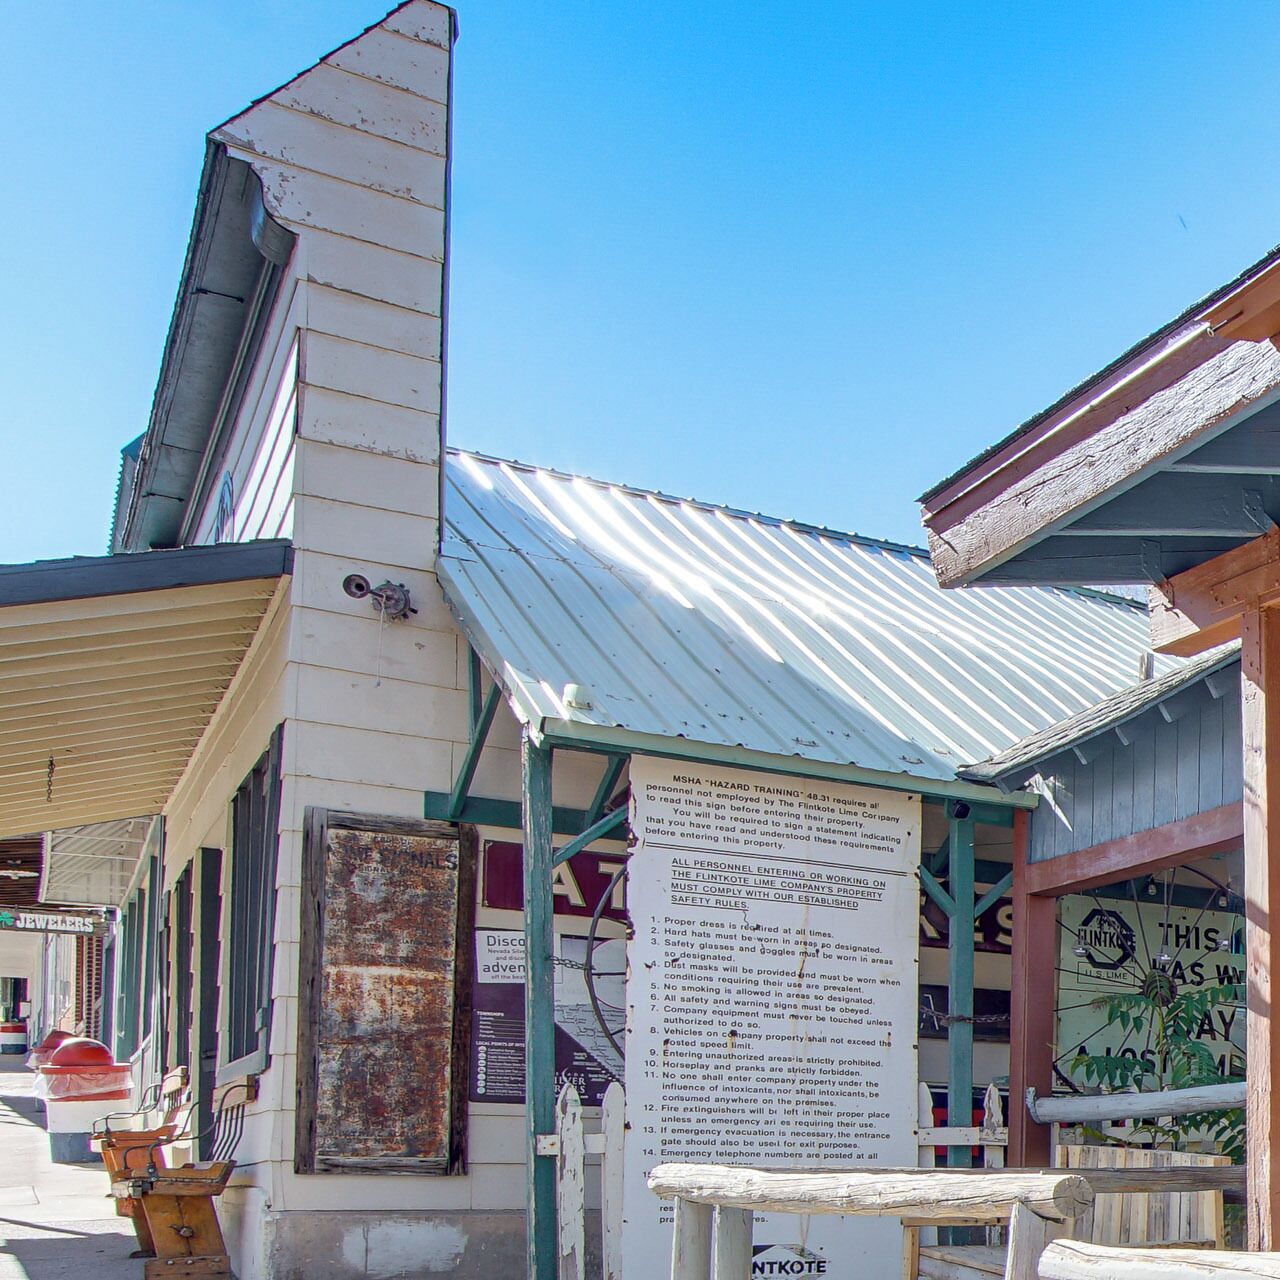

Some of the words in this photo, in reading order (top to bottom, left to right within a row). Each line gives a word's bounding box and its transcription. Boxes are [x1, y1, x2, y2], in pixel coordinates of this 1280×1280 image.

[646, 784, 693, 796] personnel
[696, 790, 713, 798] not
[716, 792, 760, 804] employed
[763, 796, 775, 807] by
[778, 798, 794, 808] The
[798, 801, 836, 814] Flintkote
[838, 807, 858, 817] Lime
[672, 775, 702, 785] MSHA
[705, 779, 750, 792] "HAZARD
[753, 785, 804, 798] TRAINING"
[806, 792, 830, 802] 48.31
[832, 797, 867, 808] requires
[646, 794, 656, 802] to
[659, 796, 682, 805] read
[684, 798, 702, 808] this
[706, 801, 726, 811] sign
[730, 803, 761, 814] before
[763, 809, 801, 820] entering
[804, 813, 824, 822] their
[826, 817, 865, 829] property.
[646, 815, 665, 825] that
[668, 819, 686, 827] you
[689, 820, 712, 830] have
[715, 825, 736, 833] read
[739, 828, 757, 836] and
[759, 830, 811, 842] understood
[813, 835, 837, 845] these
[840, 840, 894, 853] requirements
[672, 807, 691, 817] You
[694, 811, 711, 819] will
[714, 812, 726, 821] be
[729, 816, 769, 826] required
[771, 820, 781, 828] to
[784, 821, 803, 831] sign
[815, 826, 858, 838] statement
[860, 831, 901, 845] indicating
[645, 826, 676, 837] before
[680, 832, 719, 843] entering
[722, 835, 740, 844] this
[743, 839, 785, 850] property.
[671, 857, 690, 866] ALL
[693, 859, 754, 873] PERSONNEL
[757, 866, 806, 880] ENTERING
[809, 872, 823, 882] OR
[825, 874, 869, 886] WORKING
[872, 879, 886, 888] ON
[671, 869, 692, 879] THE
[695, 872, 750, 885] FLINTKOTE
[753, 878, 776, 887] LIME
[780, 880, 834, 894] COMPANY'S
[836, 887, 883, 899] PROPERTY
[670, 882, 699, 892] MUST
[702, 885, 742, 896] COMPLY
[745, 889, 770, 898] WITH
[773, 892, 794, 902] OUR
[798, 894, 859, 908] ESTABLISHED
[671, 894, 711, 905] SAFETY
[714, 898, 750, 909] RULES.
[15, 912, 95, 933] JEWELERS
[486, 935, 526, 947] Disco
[1158, 922, 1221, 953] THIS
[1106, 972, 1129, 980] LIME
[650, 982, 660, 990] 5.
[663, 983, 678, 991] No
[681, 983, 721, 995] smoking
[724, 986, 732, 994] is
[735, 987, 771, 997] allowed
[774, 990, 783, 998] in
[786, 992, 810, 1000] areas
[826, 994, 873, 1005] designated.
[650, 993, 660, 1001] 6.
[663, 993, 676, 1002] All
[680, 995, 709, 1005] safety
[712, 998, 731, 1007] and
[733, 999, 770, 1009] warning
[773, 1000, 798, 1010] signs
[824, 1004, 836, 1012] be
[839, 1006, 872, 1016] obeyed.
[644, 1059, 659, 1068] 10.
[662, 1060, 710, 1071] Horseplay
[713, 1063, 731, 1071] and
[735, 1064, 766, 1072] pranks
[787, 1066, 816, 1076] strictly
[819, 1067, 862, 1077] forbidden.
[662, 1071, 676, 1079] No
[701, 1073, 724, 1081] shall
[727, 1074, 752, 1082] enter
[755, 1076, 797, 1086] company
[799, 1078, 836, 1087] property
[837, 1079, 863, 1087] under
[865, 1080, 879, 1088] the
[662, 1082, 706, 1092] influence
[708, 1084, 719, 1092] of
[795, 1088, 816, 1096] shall
[868, 1090, 879, 1098] be
[662, 1094, 711, 1103] consumed
[714, 1096, 759, 1105] anywhere
[777, 1097, 792, 1105] the
[795, 1098, 837, 1107] premises.
[642, 1148, 657, 1156] 14.
[660, 1148, 712, 1158] Emergency
[715, 1149, 761, 1159] telephone
[764, 1150, 803, 1159] numbers
[806, 1151, 821, 1159] are
[823, 1152, 853, 1160] posted
[867, 1152, 878, 1160] all
[751, 1259, 827, 1275] NTKOTE
